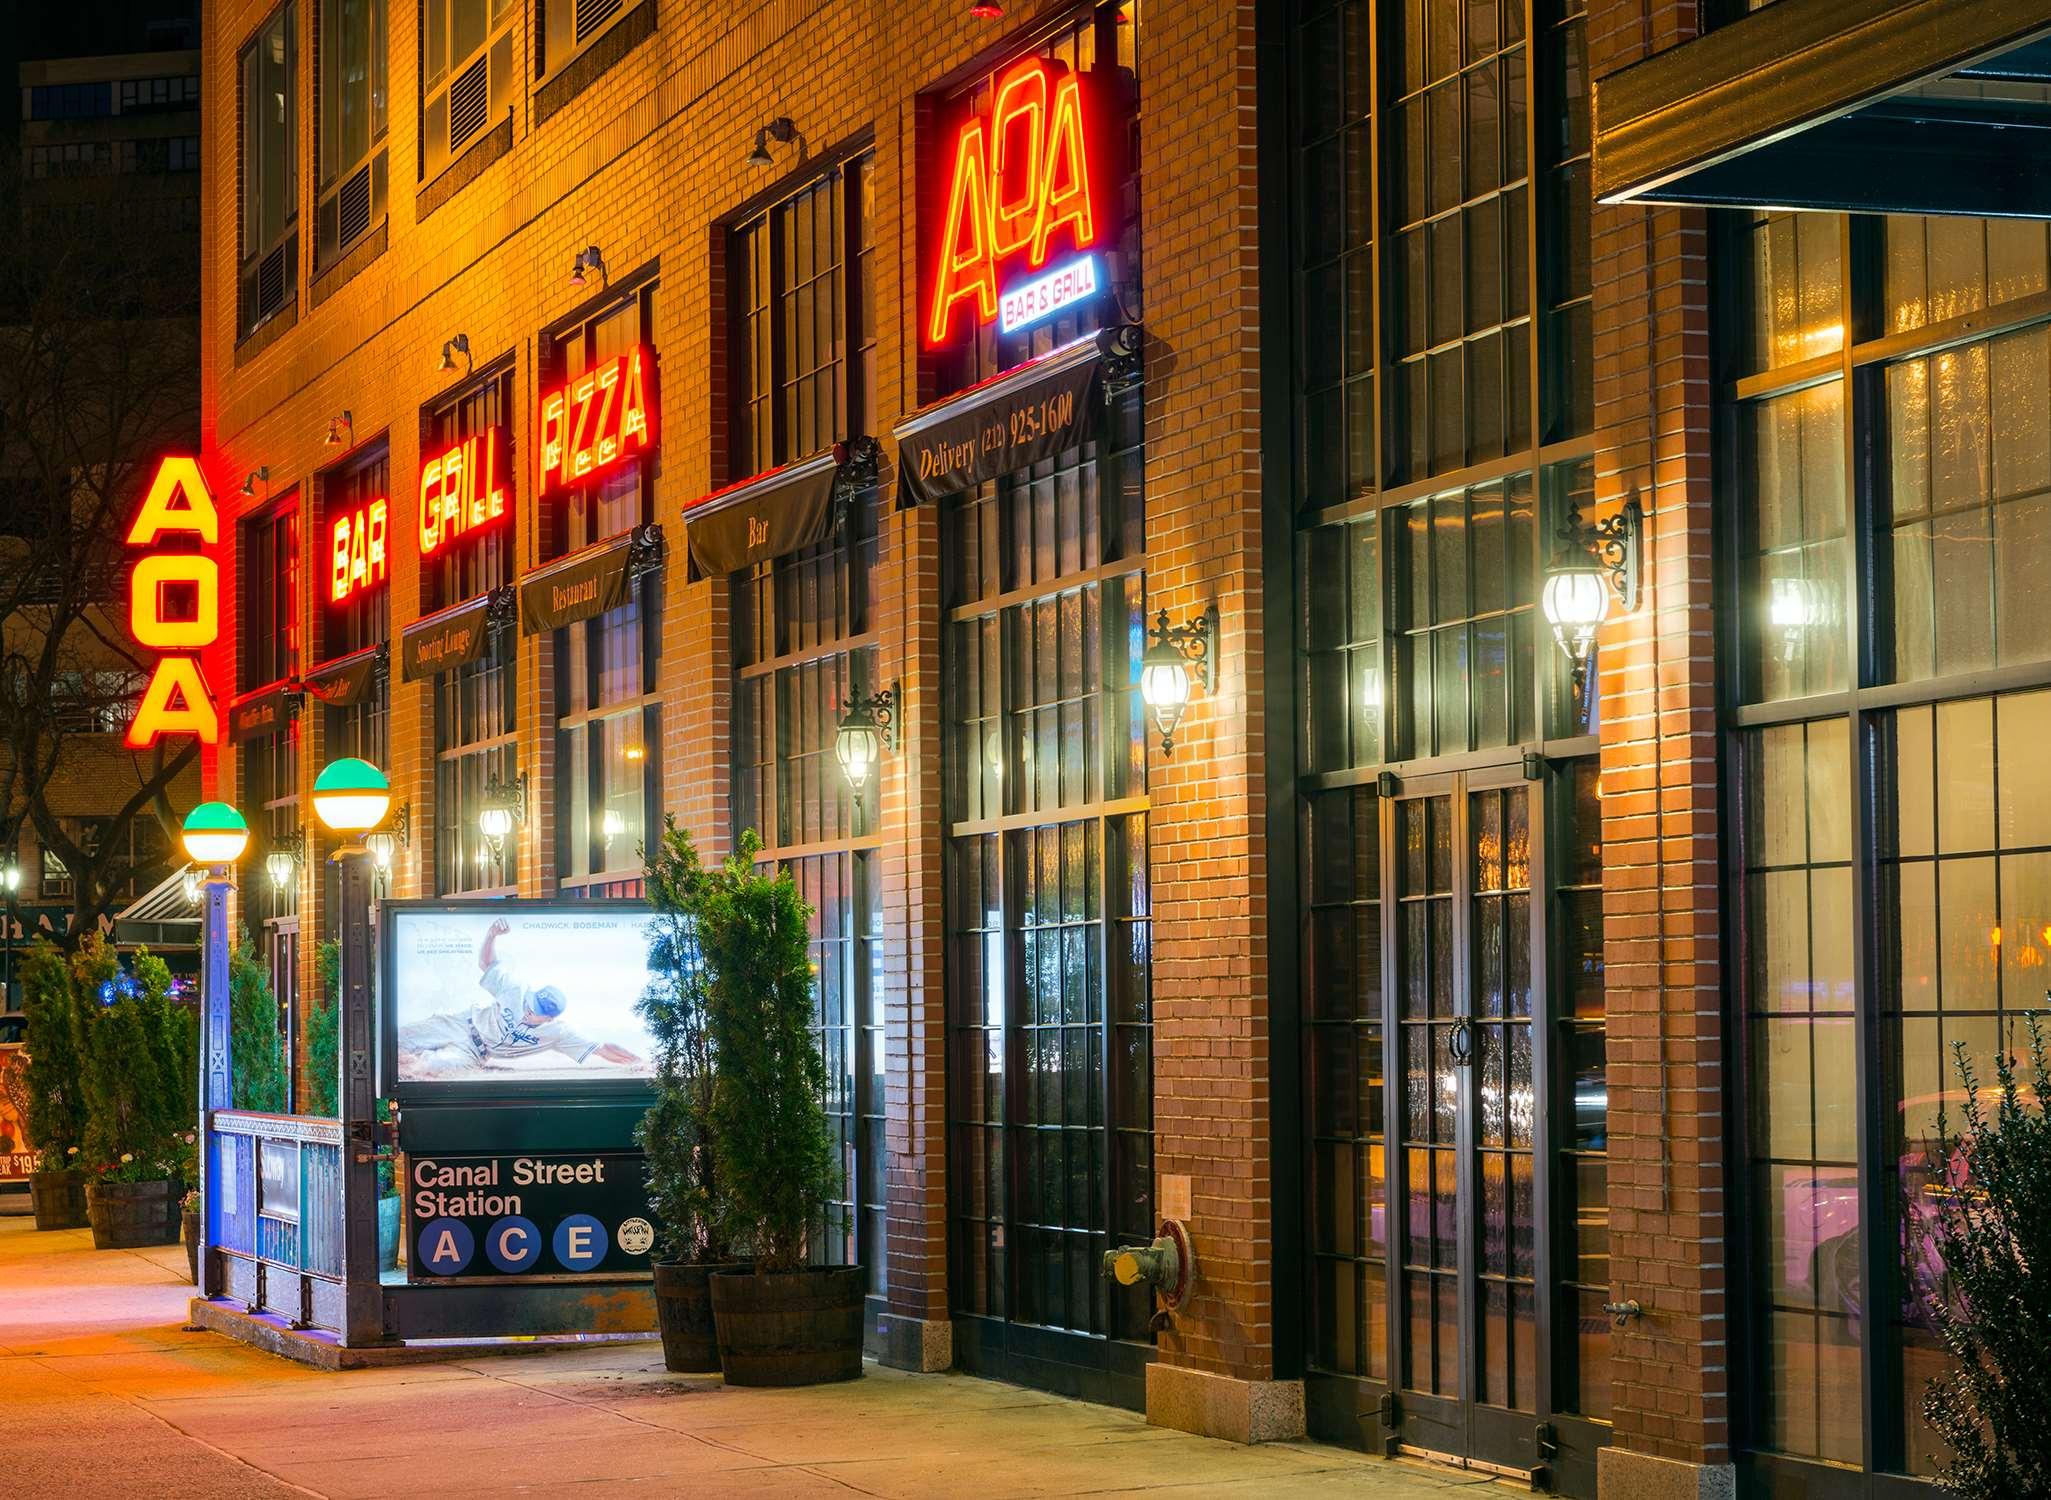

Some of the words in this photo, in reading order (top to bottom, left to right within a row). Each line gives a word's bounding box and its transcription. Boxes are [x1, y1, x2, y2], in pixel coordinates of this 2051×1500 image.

[928, 60, 1095, 346] AOA
[1005, 290, 1035, 328] BAR
[1053, 263, 1093, 305] GRILL
[538, 346, 648, 497] PIZZA
[919, 437, 977, 482] Delivery
[981, 422, 1007, 457] (212)
[1010, 389, 1074, 448] 925-1600
[418, 425, 504, 555] GRILL
[331, 497, 387, 602] BAR
[747, 516, 769, 549] Bar
[125, 456, 218, 748] AOA
[552, 573, 598, 613] Restaurant
[416, 634, 444, 666] Sporting
[445, 629, 471, 655] Lounge
[522, 921, 570, 930] CHADWICK
[573, 921, 618, 930] BOSEMAN
[414, 1159, 498, 1188] Canal
[513, 1158, 605, 1186] Street
[414, 1190, 521, 1218] Station
[432, 1230, 461, 1263] A
[499, 1227, 528, 1262] C
[568, 1226, 592, 1259] E
